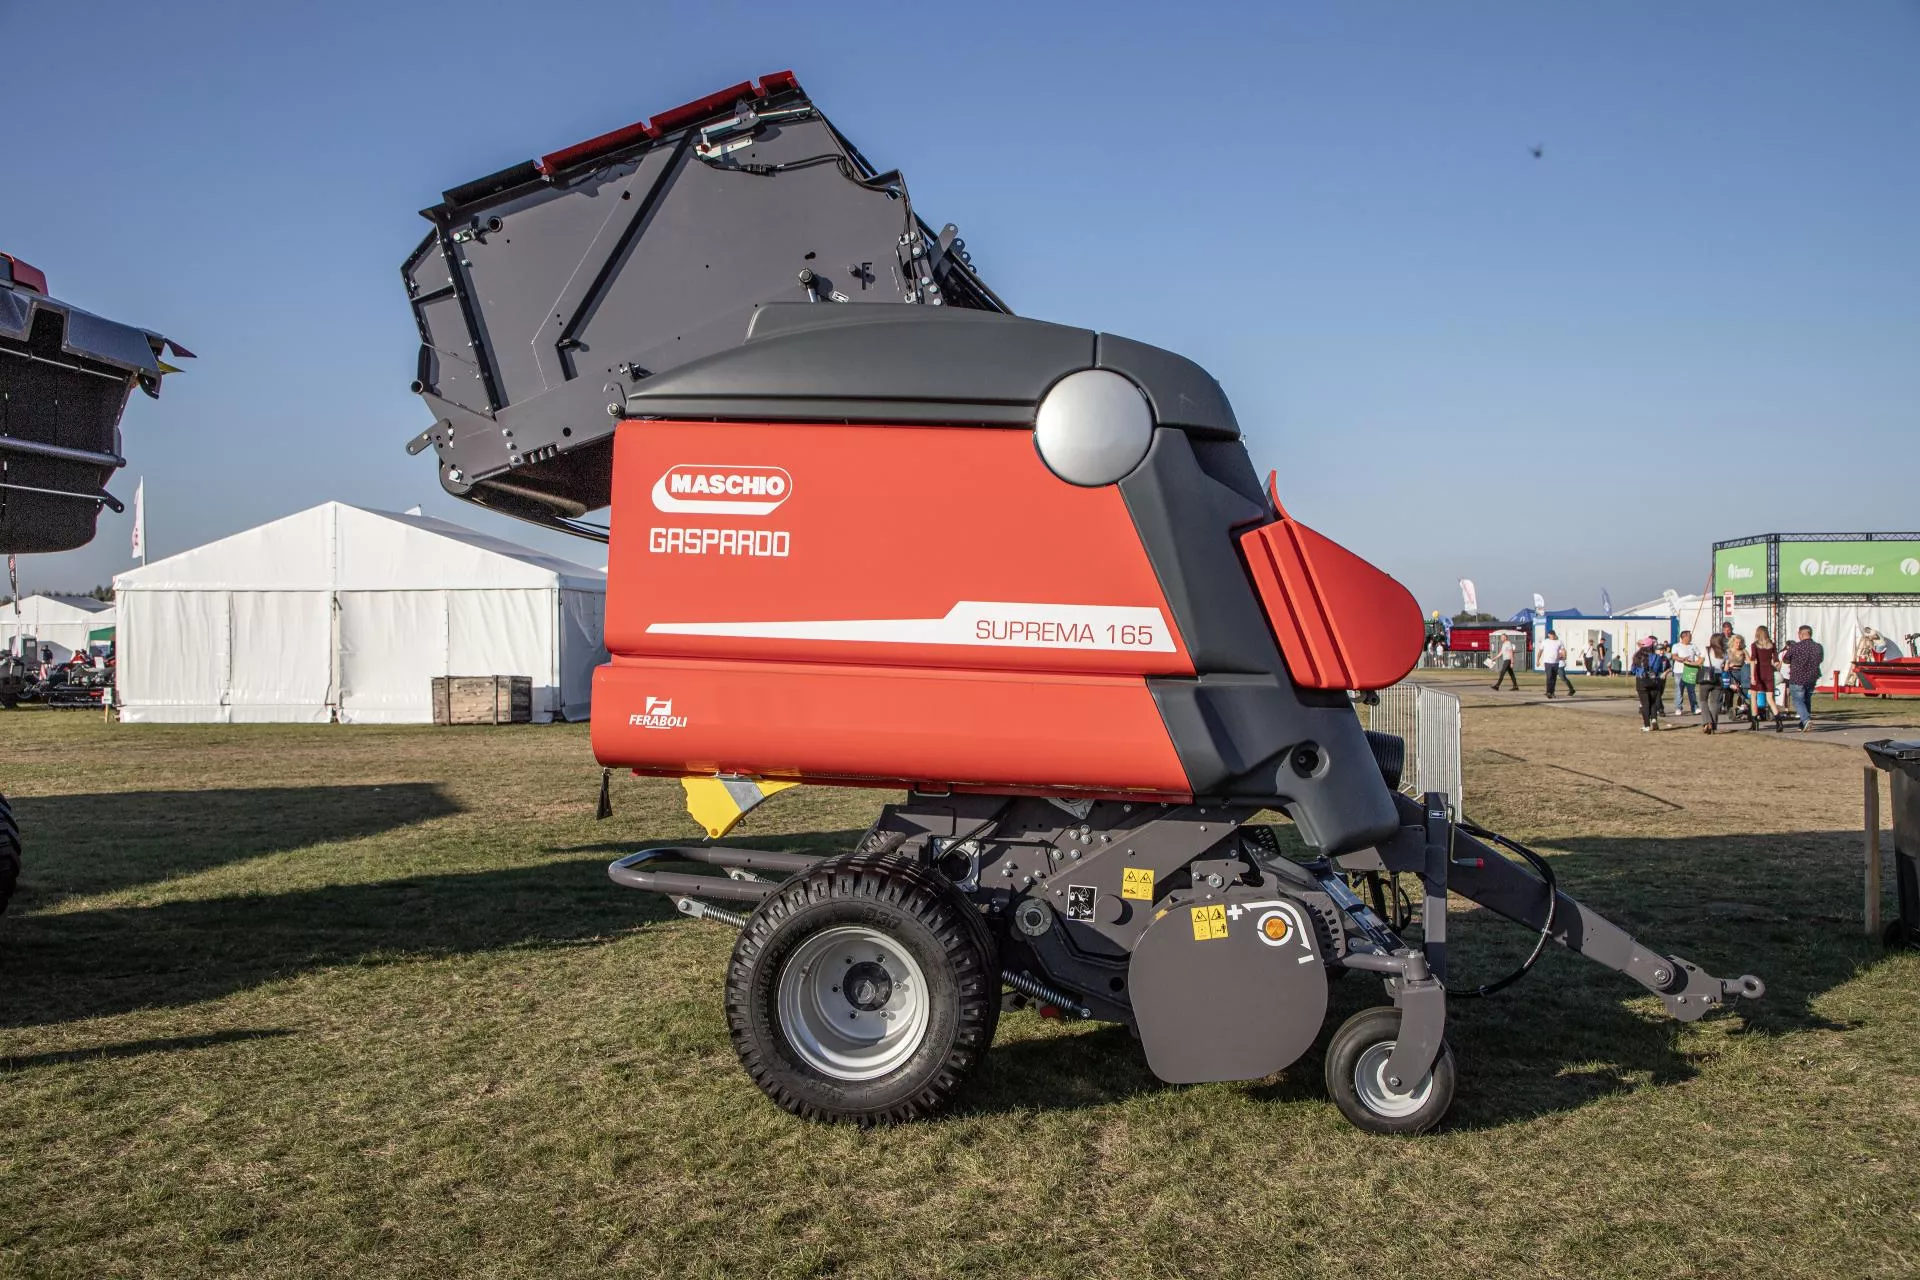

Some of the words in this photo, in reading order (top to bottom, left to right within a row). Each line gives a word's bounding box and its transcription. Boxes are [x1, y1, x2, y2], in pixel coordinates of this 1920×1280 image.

[671, 474, 785, 496] MASCHIO
[649, 527, 790, 557] GASPARDO
[1725, 596, 1732, 616] E
[975, 619, 1095, 644] SUPREMA
[1105, 624, 1153, 646] 165
[629, 714, 688, 728] FERABOLI
